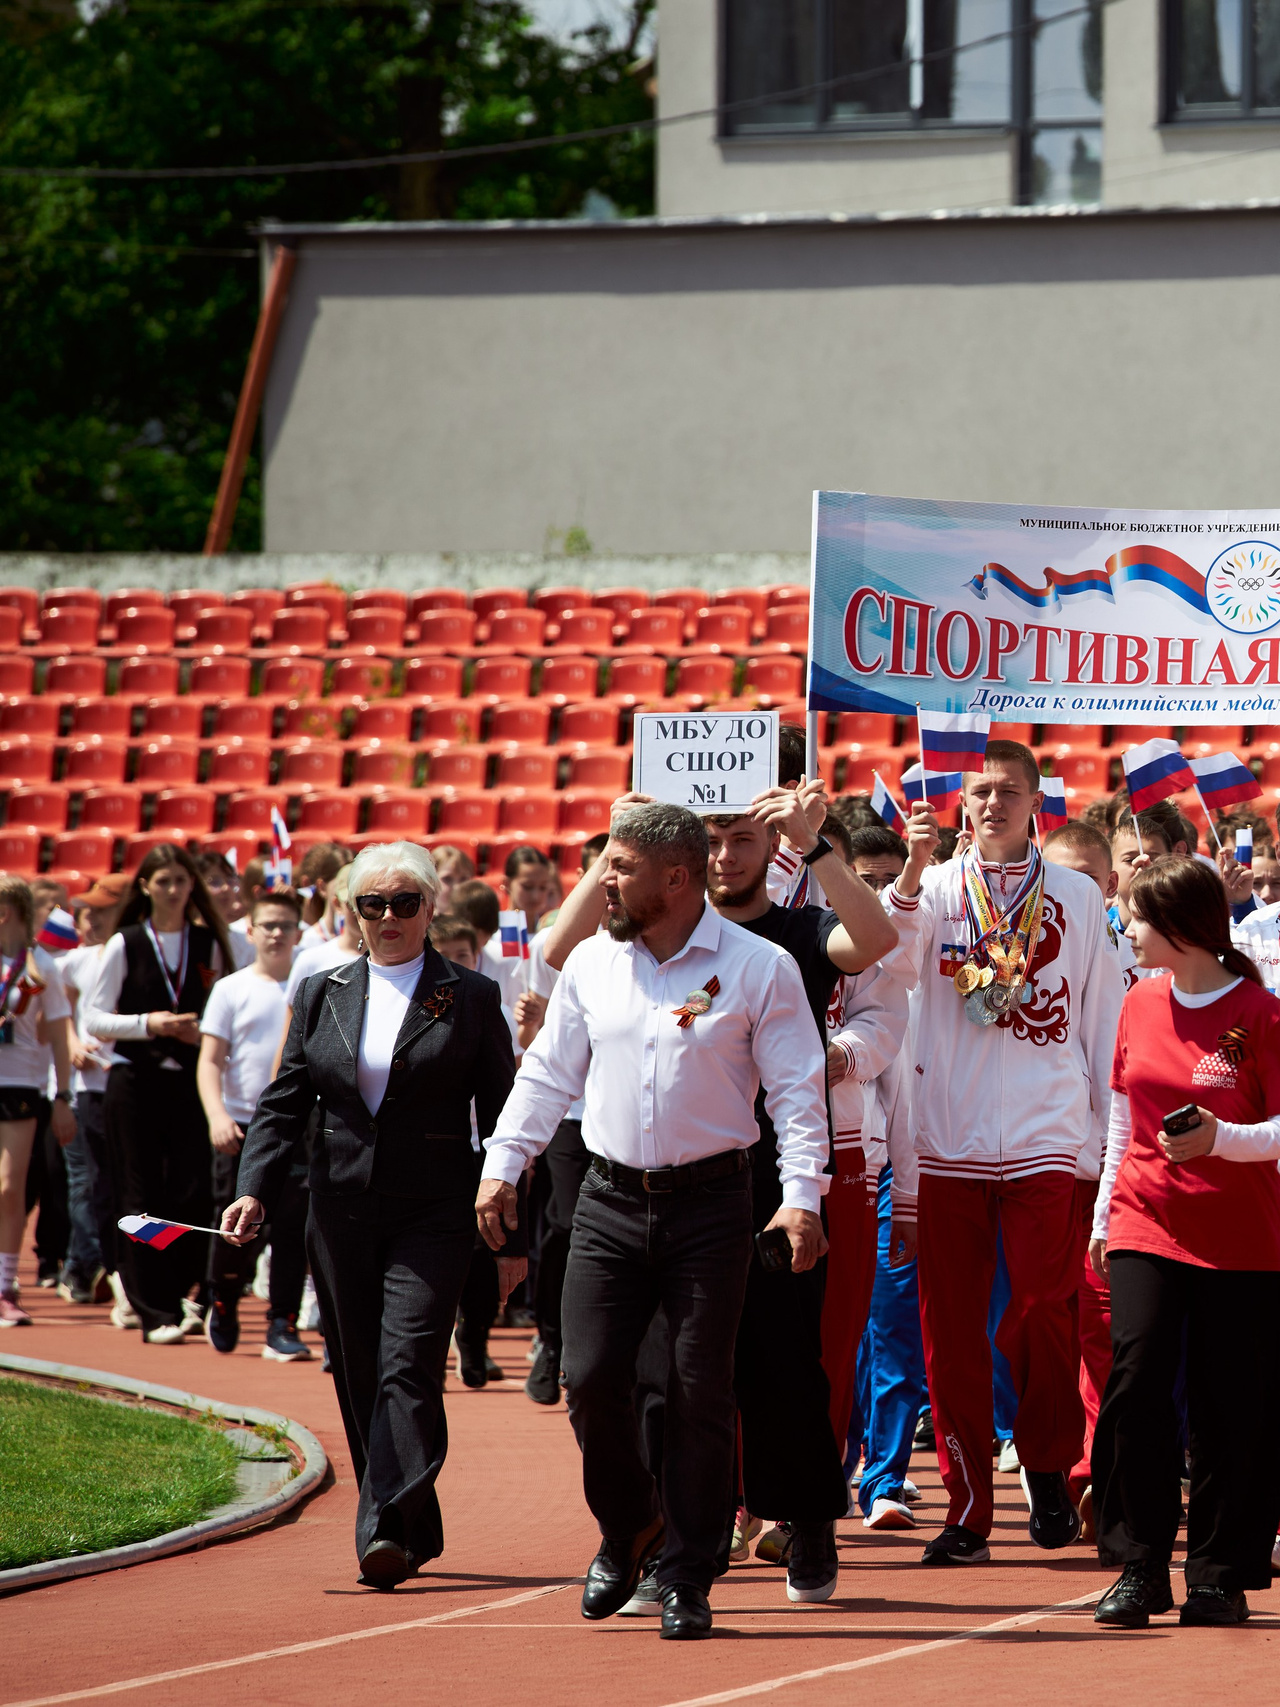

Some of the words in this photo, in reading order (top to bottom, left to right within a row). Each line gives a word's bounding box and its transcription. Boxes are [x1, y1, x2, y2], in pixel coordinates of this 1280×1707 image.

[1019, 518, 1127, 532] МУНИЦИПАЛЬНОЕ
[1129, 522, 1204, 534] БЮДЖЕТНОЕ
[968, 688, 1047, 713] Дорога
[1052, 696, 1067, 709] к
[1071, 694, 1218, 711] олимпийским
[655, 719, 719, 740] МБУ
[725, 718, 767, 744] ДО
[665, 750, 755, 772] СШОР
[687, 783, 728, 804] №1
[1191, 1078, 1236, 1089] ПЯТИГОРСКА
